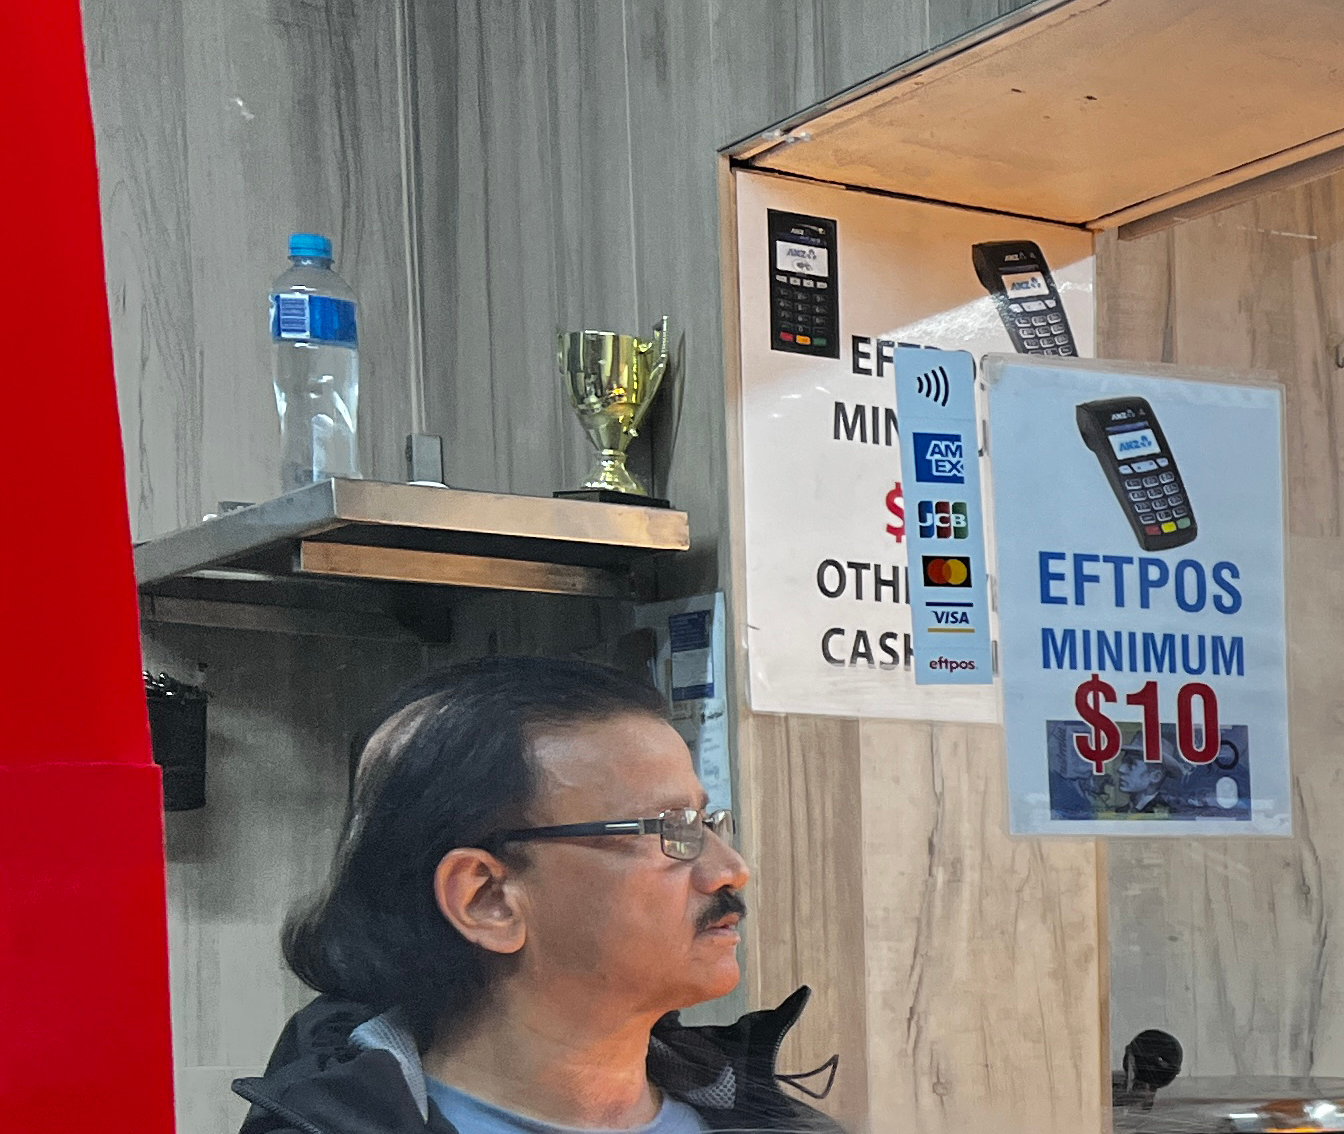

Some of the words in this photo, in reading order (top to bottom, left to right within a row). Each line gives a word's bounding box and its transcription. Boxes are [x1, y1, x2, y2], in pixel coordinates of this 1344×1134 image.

[919, 513, 967, 529] JCB
[1039, 551, 1243, 615] EFTPOS
[932, 611, 969, 625] VISA
[929, 657, 975, 672] eftpos
[1041, 627, 1244, 677] MINIMUM
[1074, 674, 1219, 774] $10
